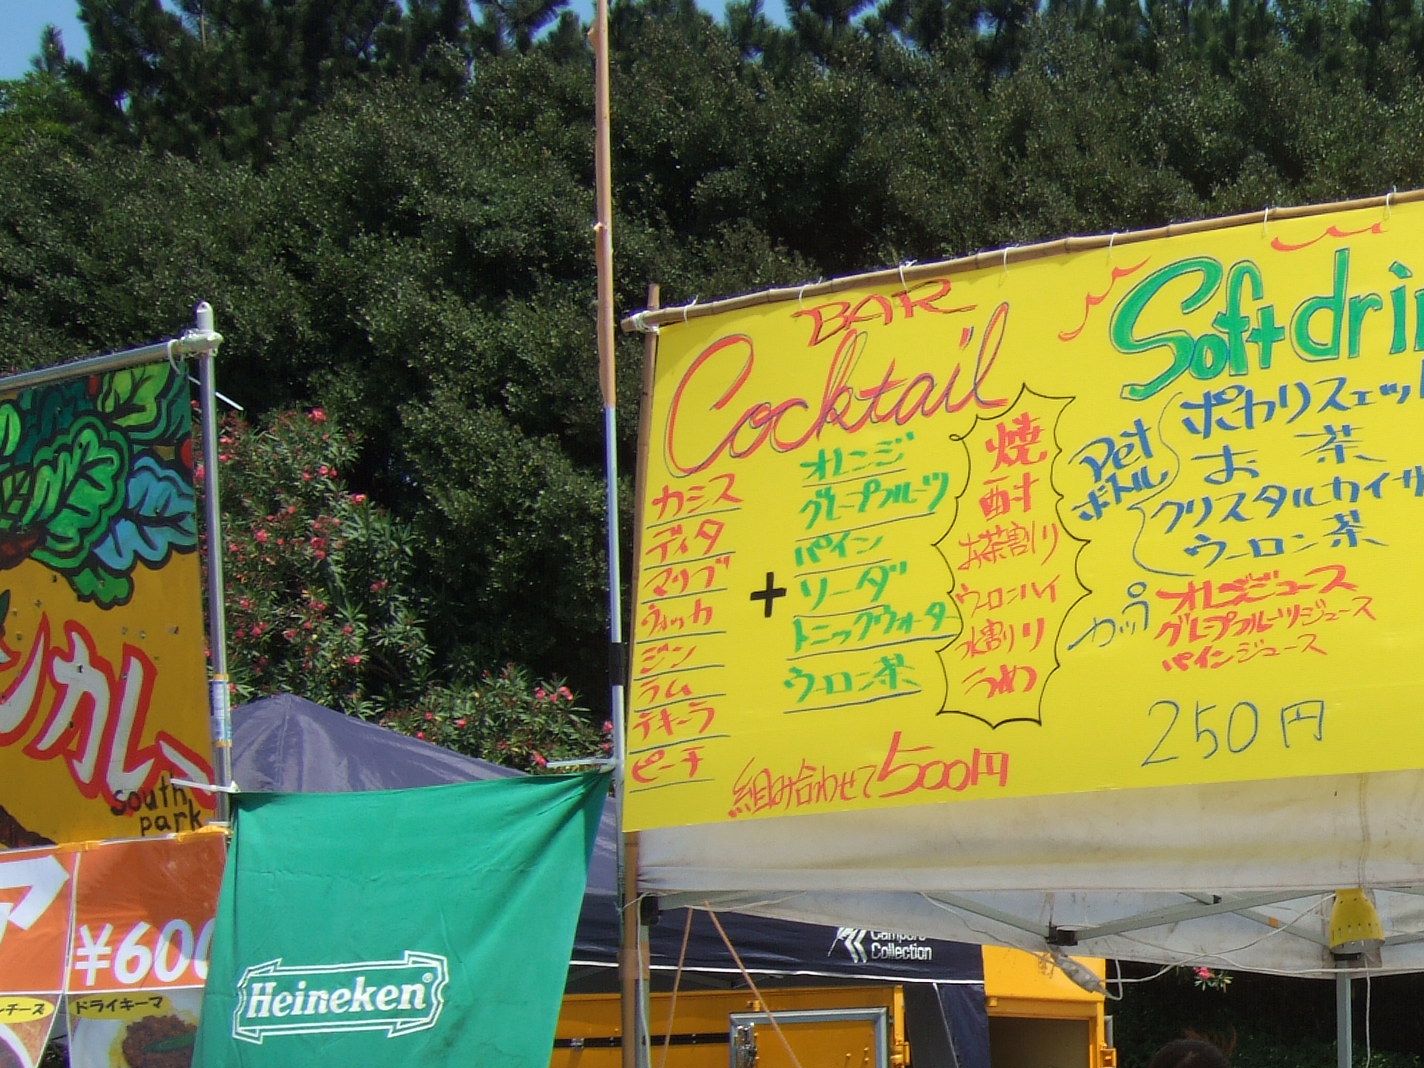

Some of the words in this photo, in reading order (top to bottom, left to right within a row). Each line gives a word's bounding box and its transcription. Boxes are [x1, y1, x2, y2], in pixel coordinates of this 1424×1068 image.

[791, 278, 977, 347] BAR
[1109, 256, 1286, 400] Soft
[663, 304, 1010, 478] Cocktail
[870, 942, 933, 961] Collection
[76, 996, 163, 1014] ドライキーマ
[246, 976, 428, 1019] Heineken
